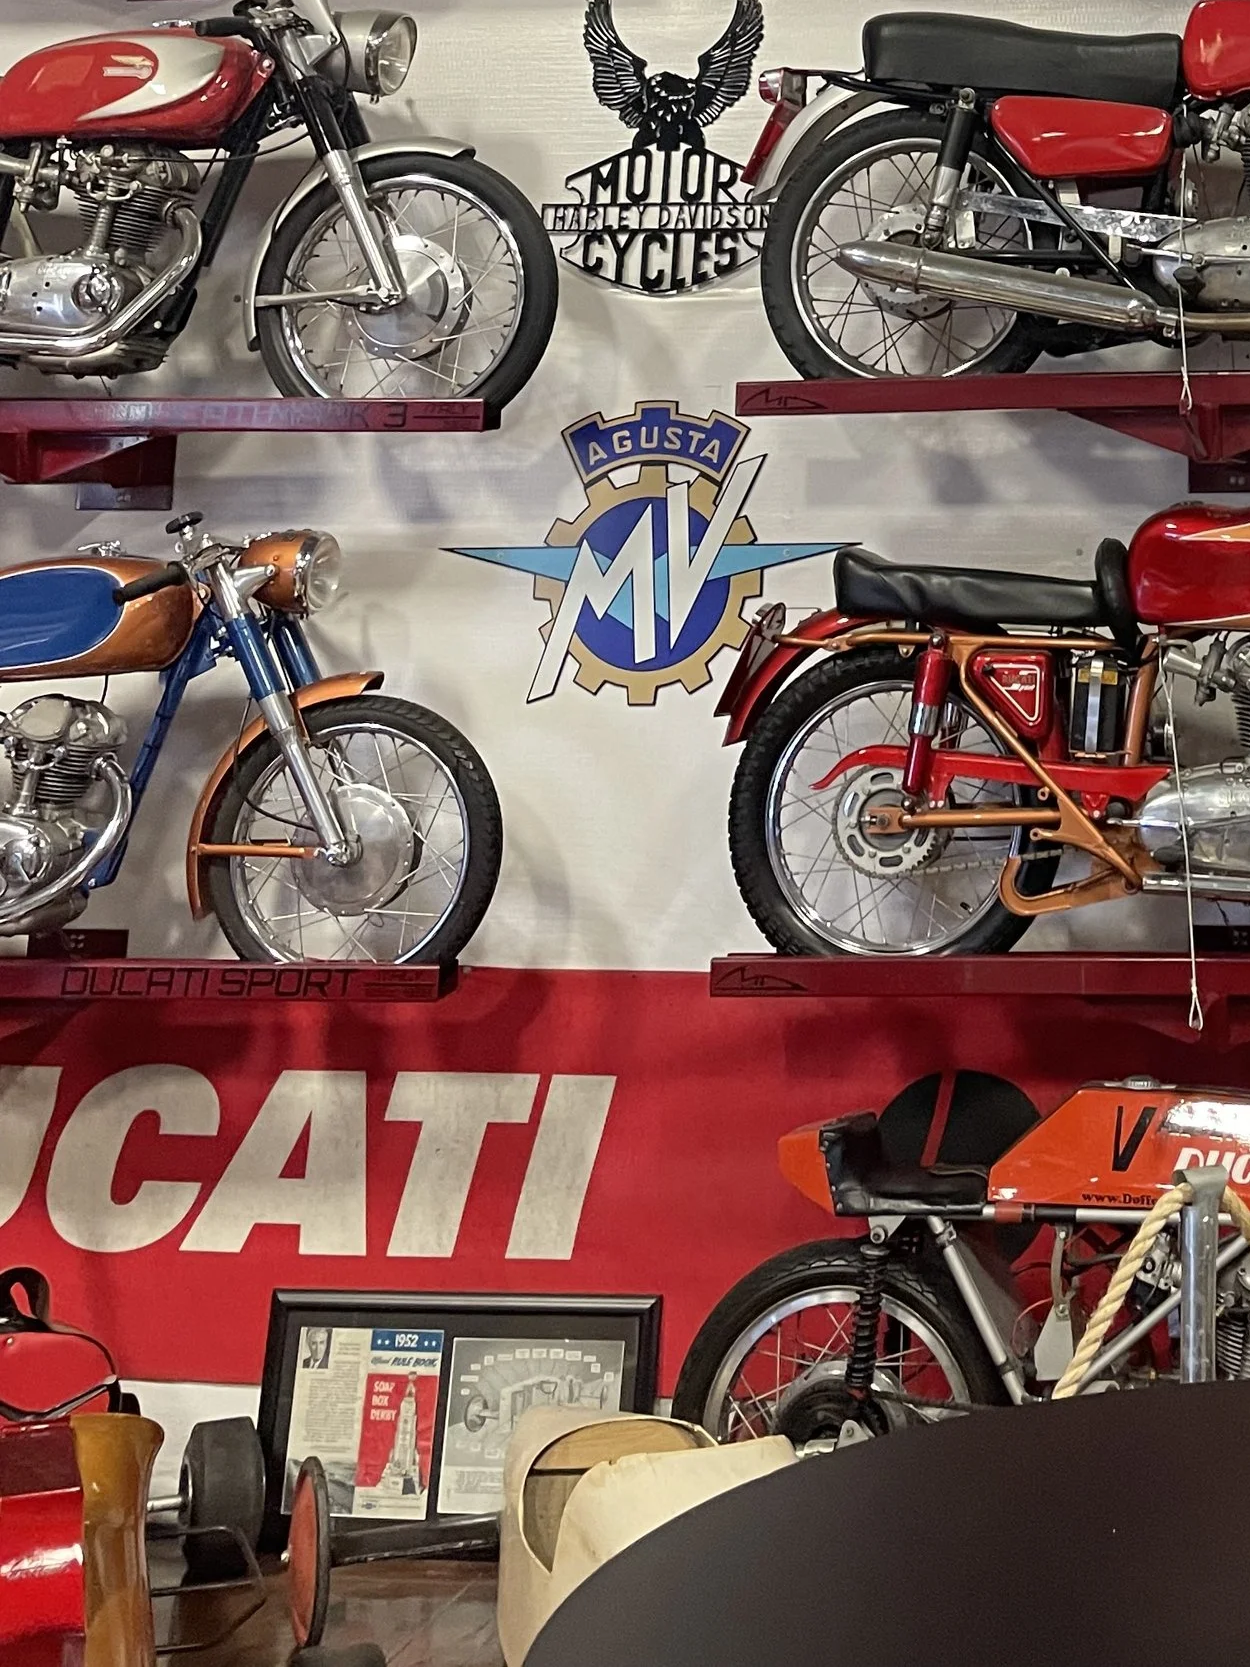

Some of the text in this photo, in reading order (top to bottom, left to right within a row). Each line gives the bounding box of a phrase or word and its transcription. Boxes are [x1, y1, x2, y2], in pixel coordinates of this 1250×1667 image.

[588, 147, 741, 204] MOTOR
[553, 204, 771, 231] HARLEY DAVIDSON
[581, 232, 739, 291] CYCLES
[383, 402, 407, 428] 3
[587, 426, 722, 466] AGUSTA
[526, 453, 768, 704] MV
[60, 966, 207, 998] DUCATI
[217, 967, 361, 997] SPORT
[1111, 1104, 1158, 1172] V
[394, 1333, 419, 1348] 1952
[391, 1356, 413, 1367] RULE
[373, 1380, 395, 1393] SOAP
[371, 1394, 390, 1407] BOX
[369, 1408, 397, 1422] DERBY
